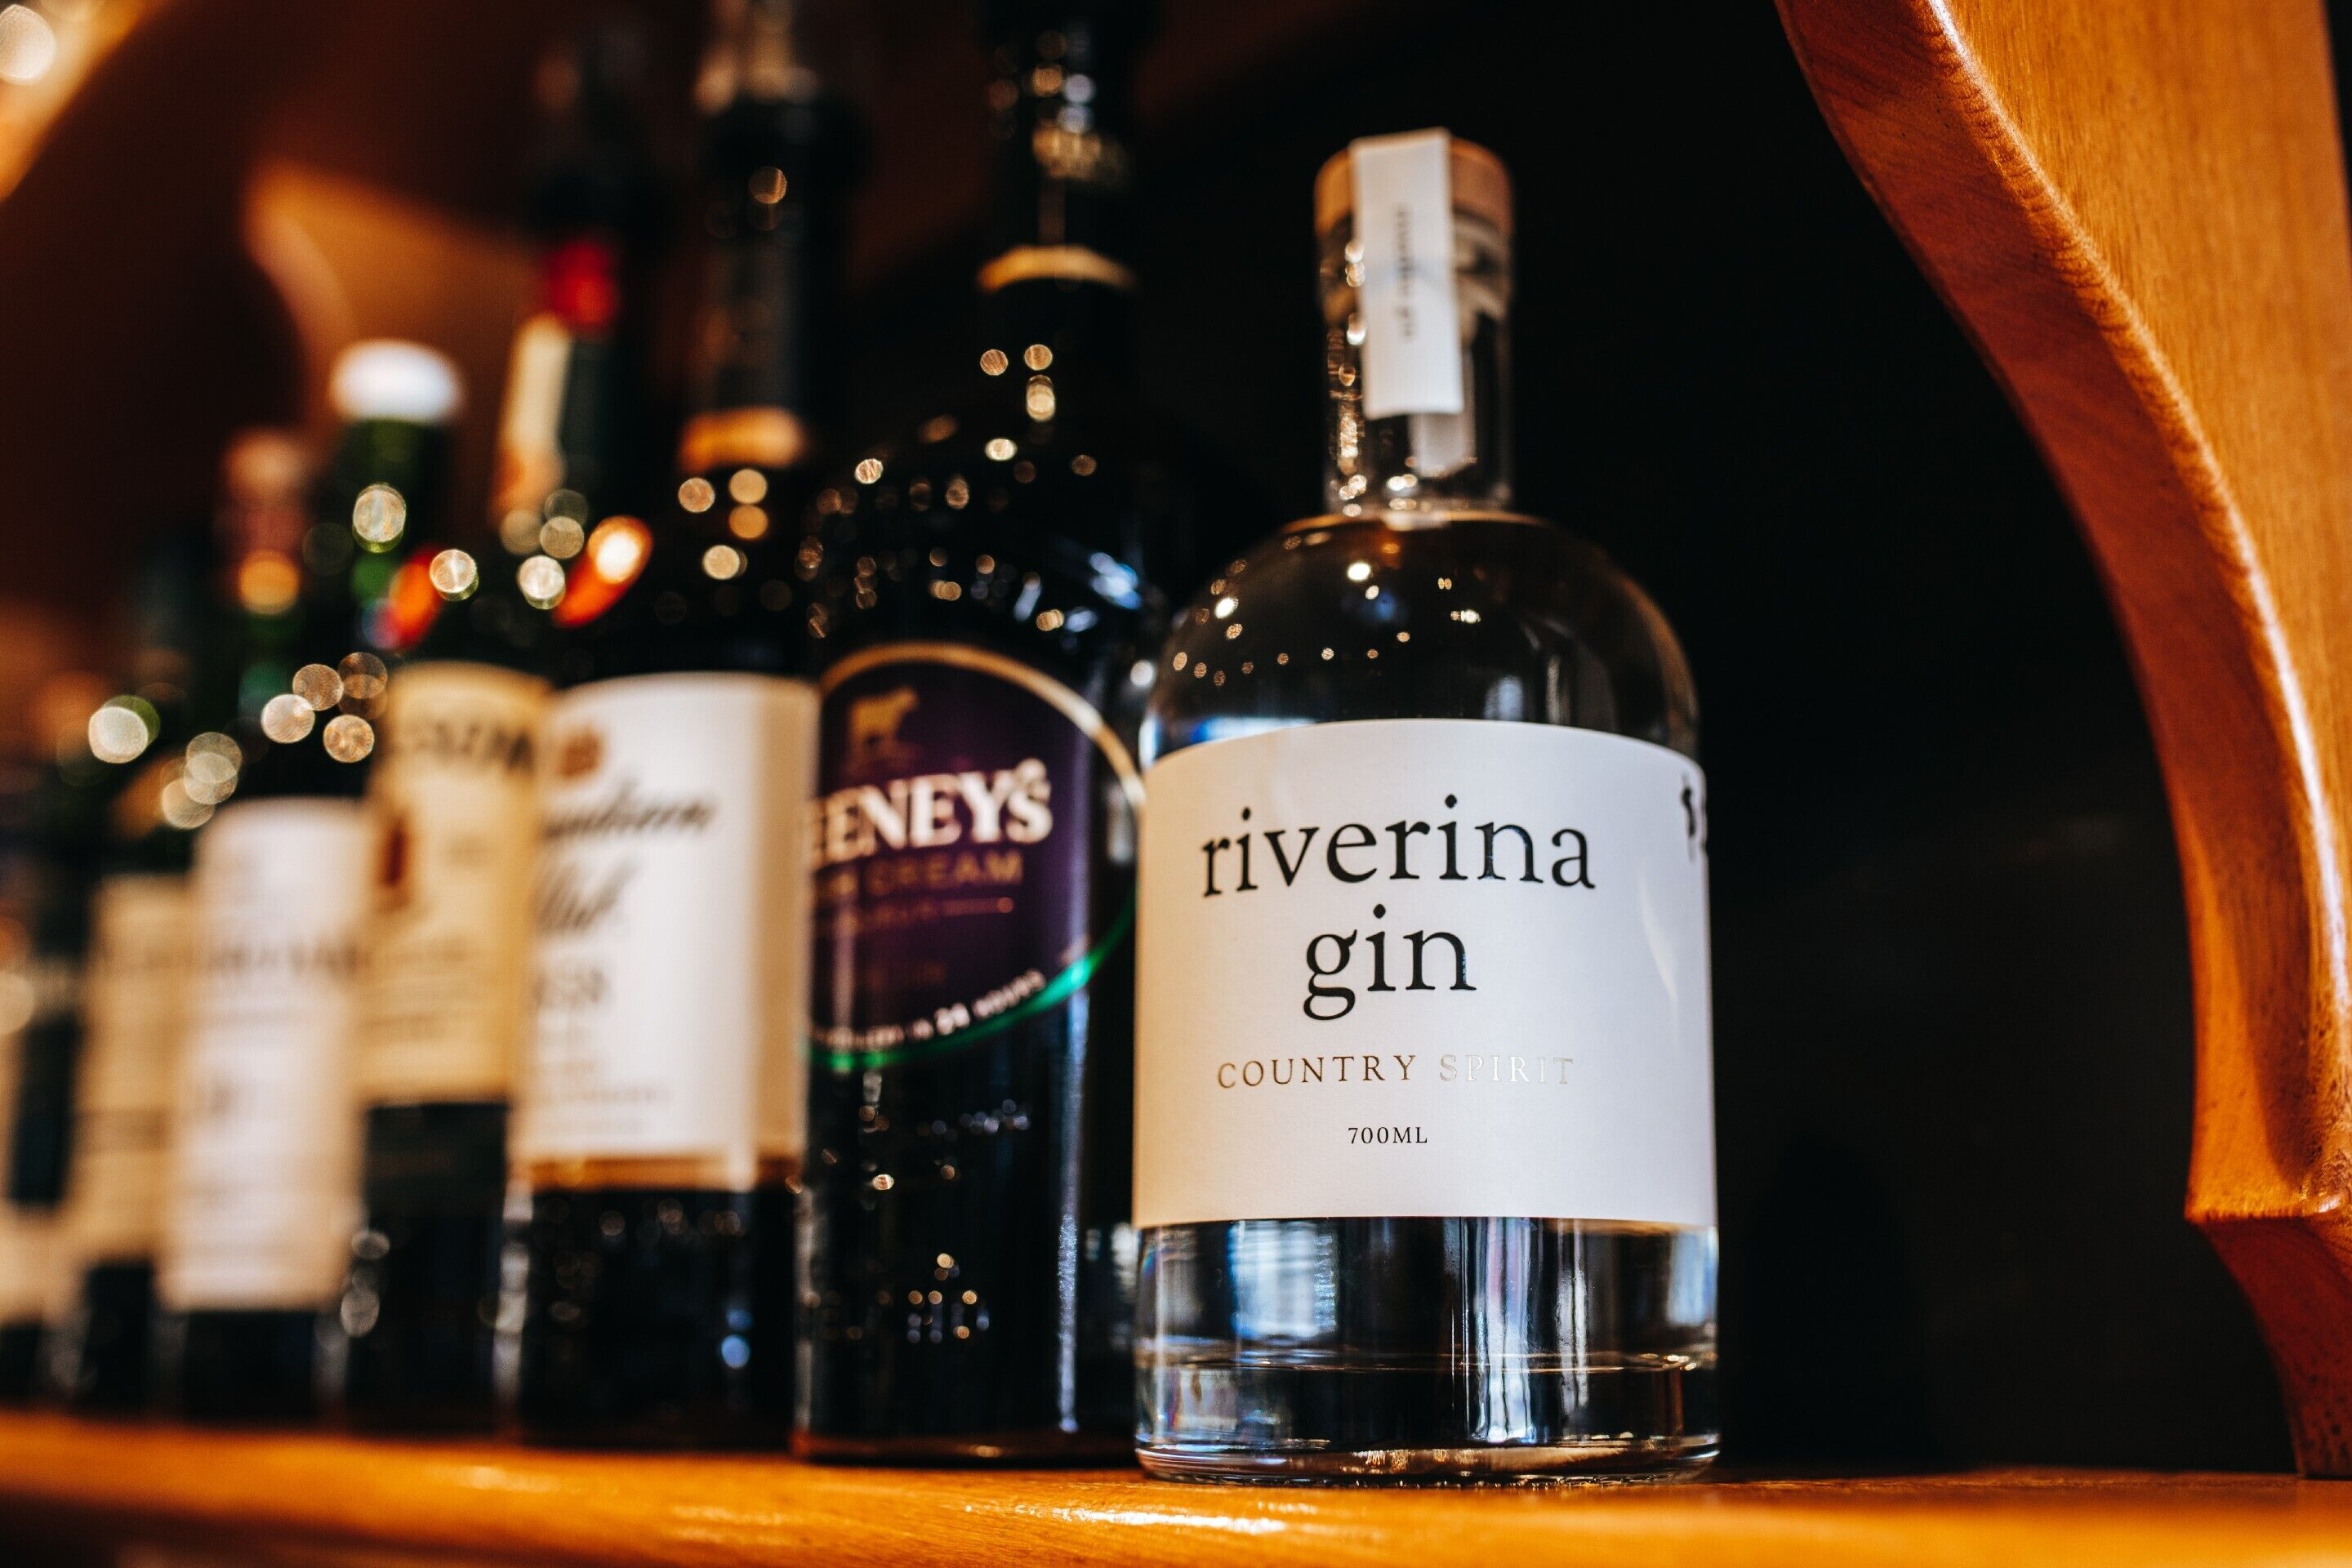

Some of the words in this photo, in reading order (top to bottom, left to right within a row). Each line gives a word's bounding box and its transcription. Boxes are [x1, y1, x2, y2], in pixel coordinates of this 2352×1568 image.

[1200, 794, 1596, 897] riverina
[1303, 903, 1477, 1021] gin
[1217, 1054, 1416, 1089] COUNTRY
[1438, 1054, 1574, 1085] SPIRIT
[1348, 1126, 1428, 1144] 700ML
